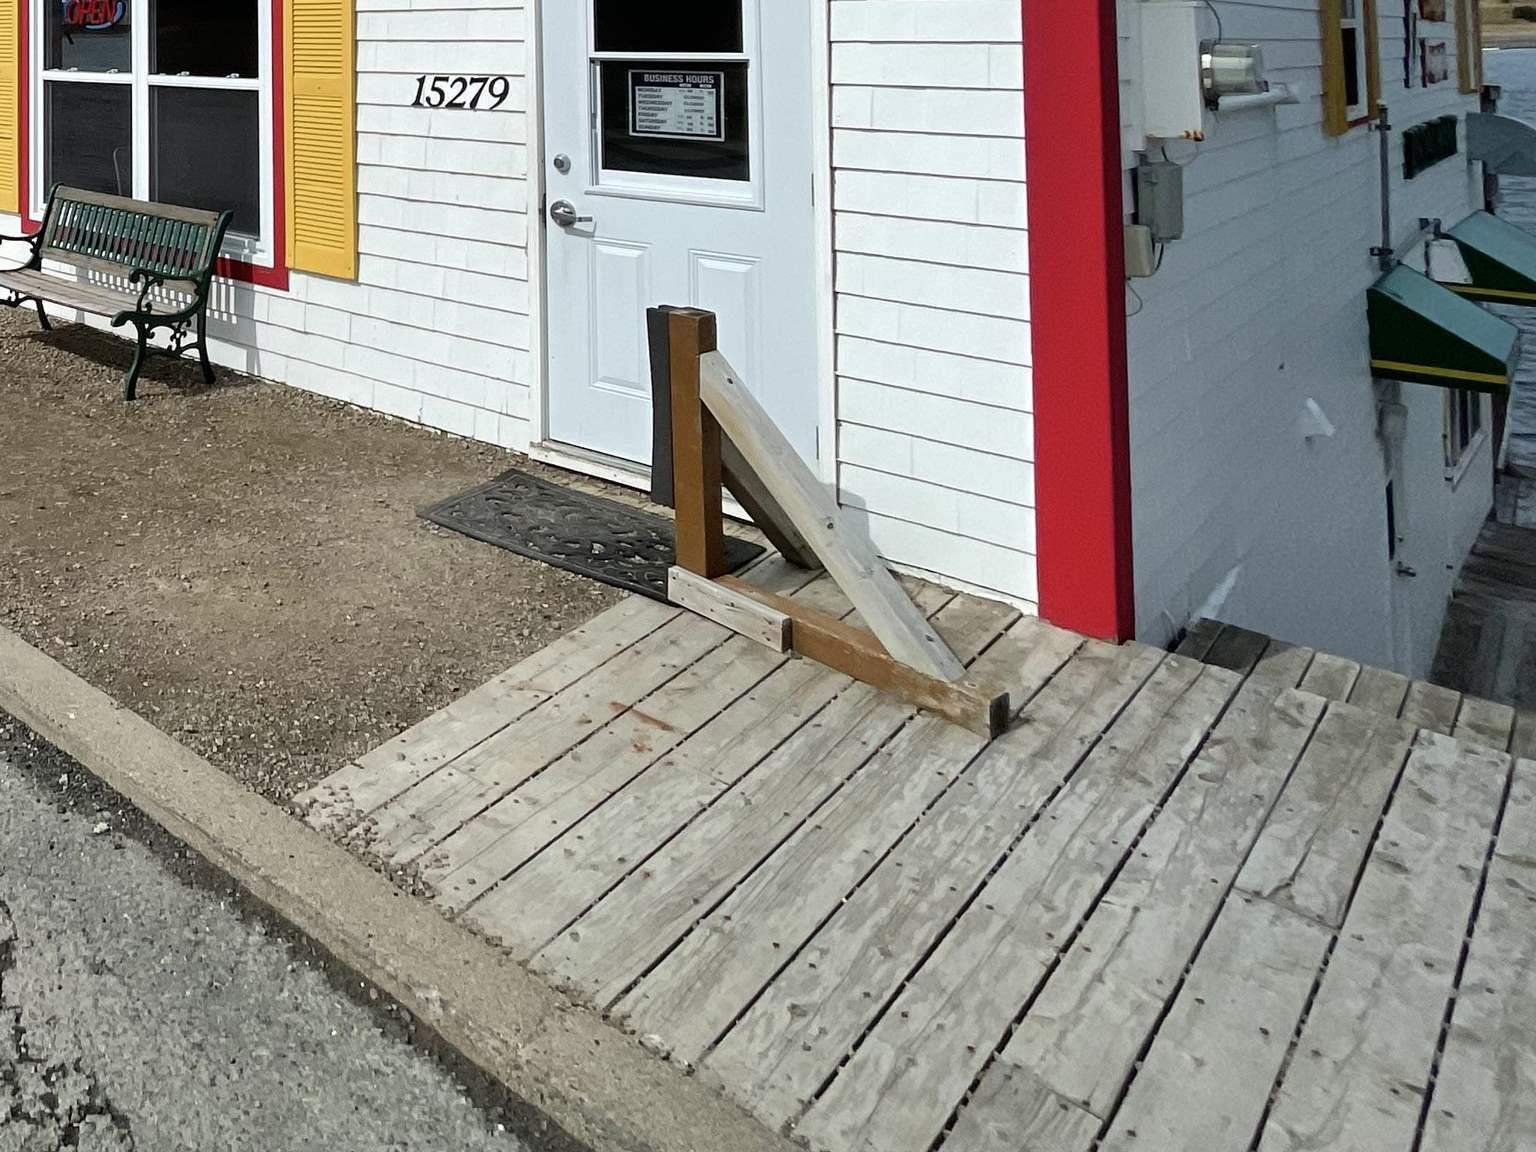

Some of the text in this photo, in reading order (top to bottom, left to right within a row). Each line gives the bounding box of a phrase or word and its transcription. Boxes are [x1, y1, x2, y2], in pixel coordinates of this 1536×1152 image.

[644, 73, 715, 84] BUSINESS HOURS
[410, 75, 510, 110] 15279
